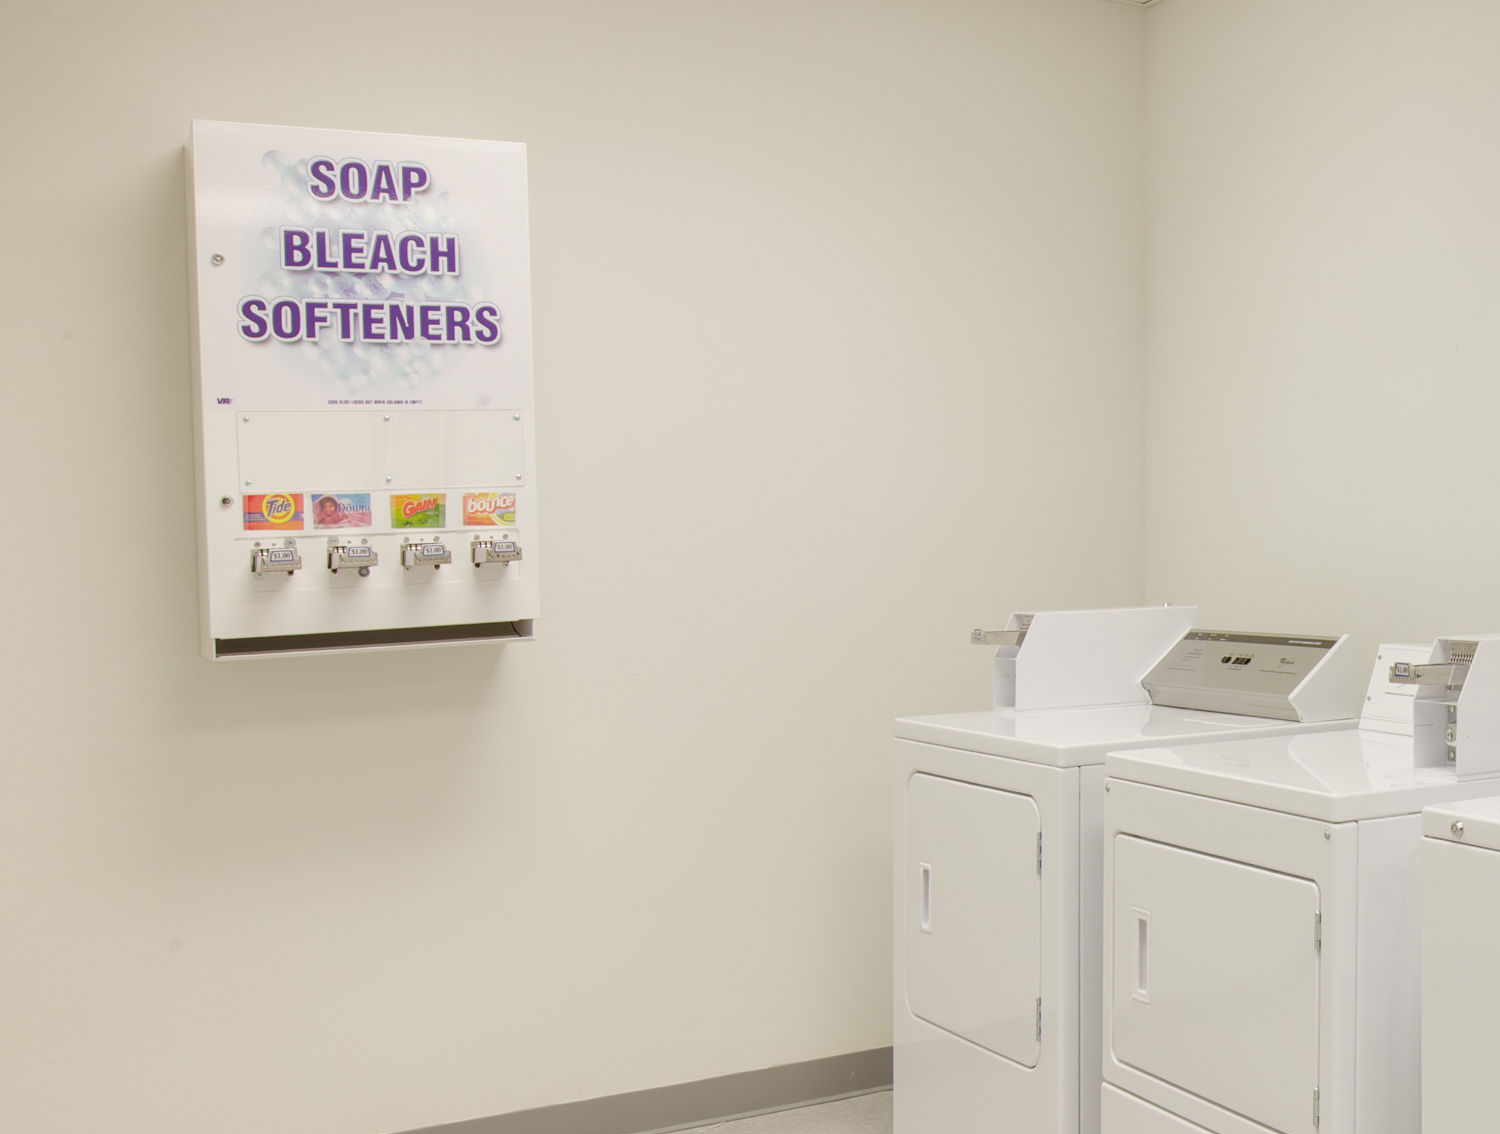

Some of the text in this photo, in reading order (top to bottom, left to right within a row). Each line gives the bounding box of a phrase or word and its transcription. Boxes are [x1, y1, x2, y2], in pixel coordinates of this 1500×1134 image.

[309, 159, 428, 202] SOAP
[282, 229, 457, 274] BLEACH
[240, 298, 500, 343] SOFTENERS
[265, 499, 292, 518] Tide
[467, 494, 514, 514] bounce
[273, 552, 291, 560] $1.00
